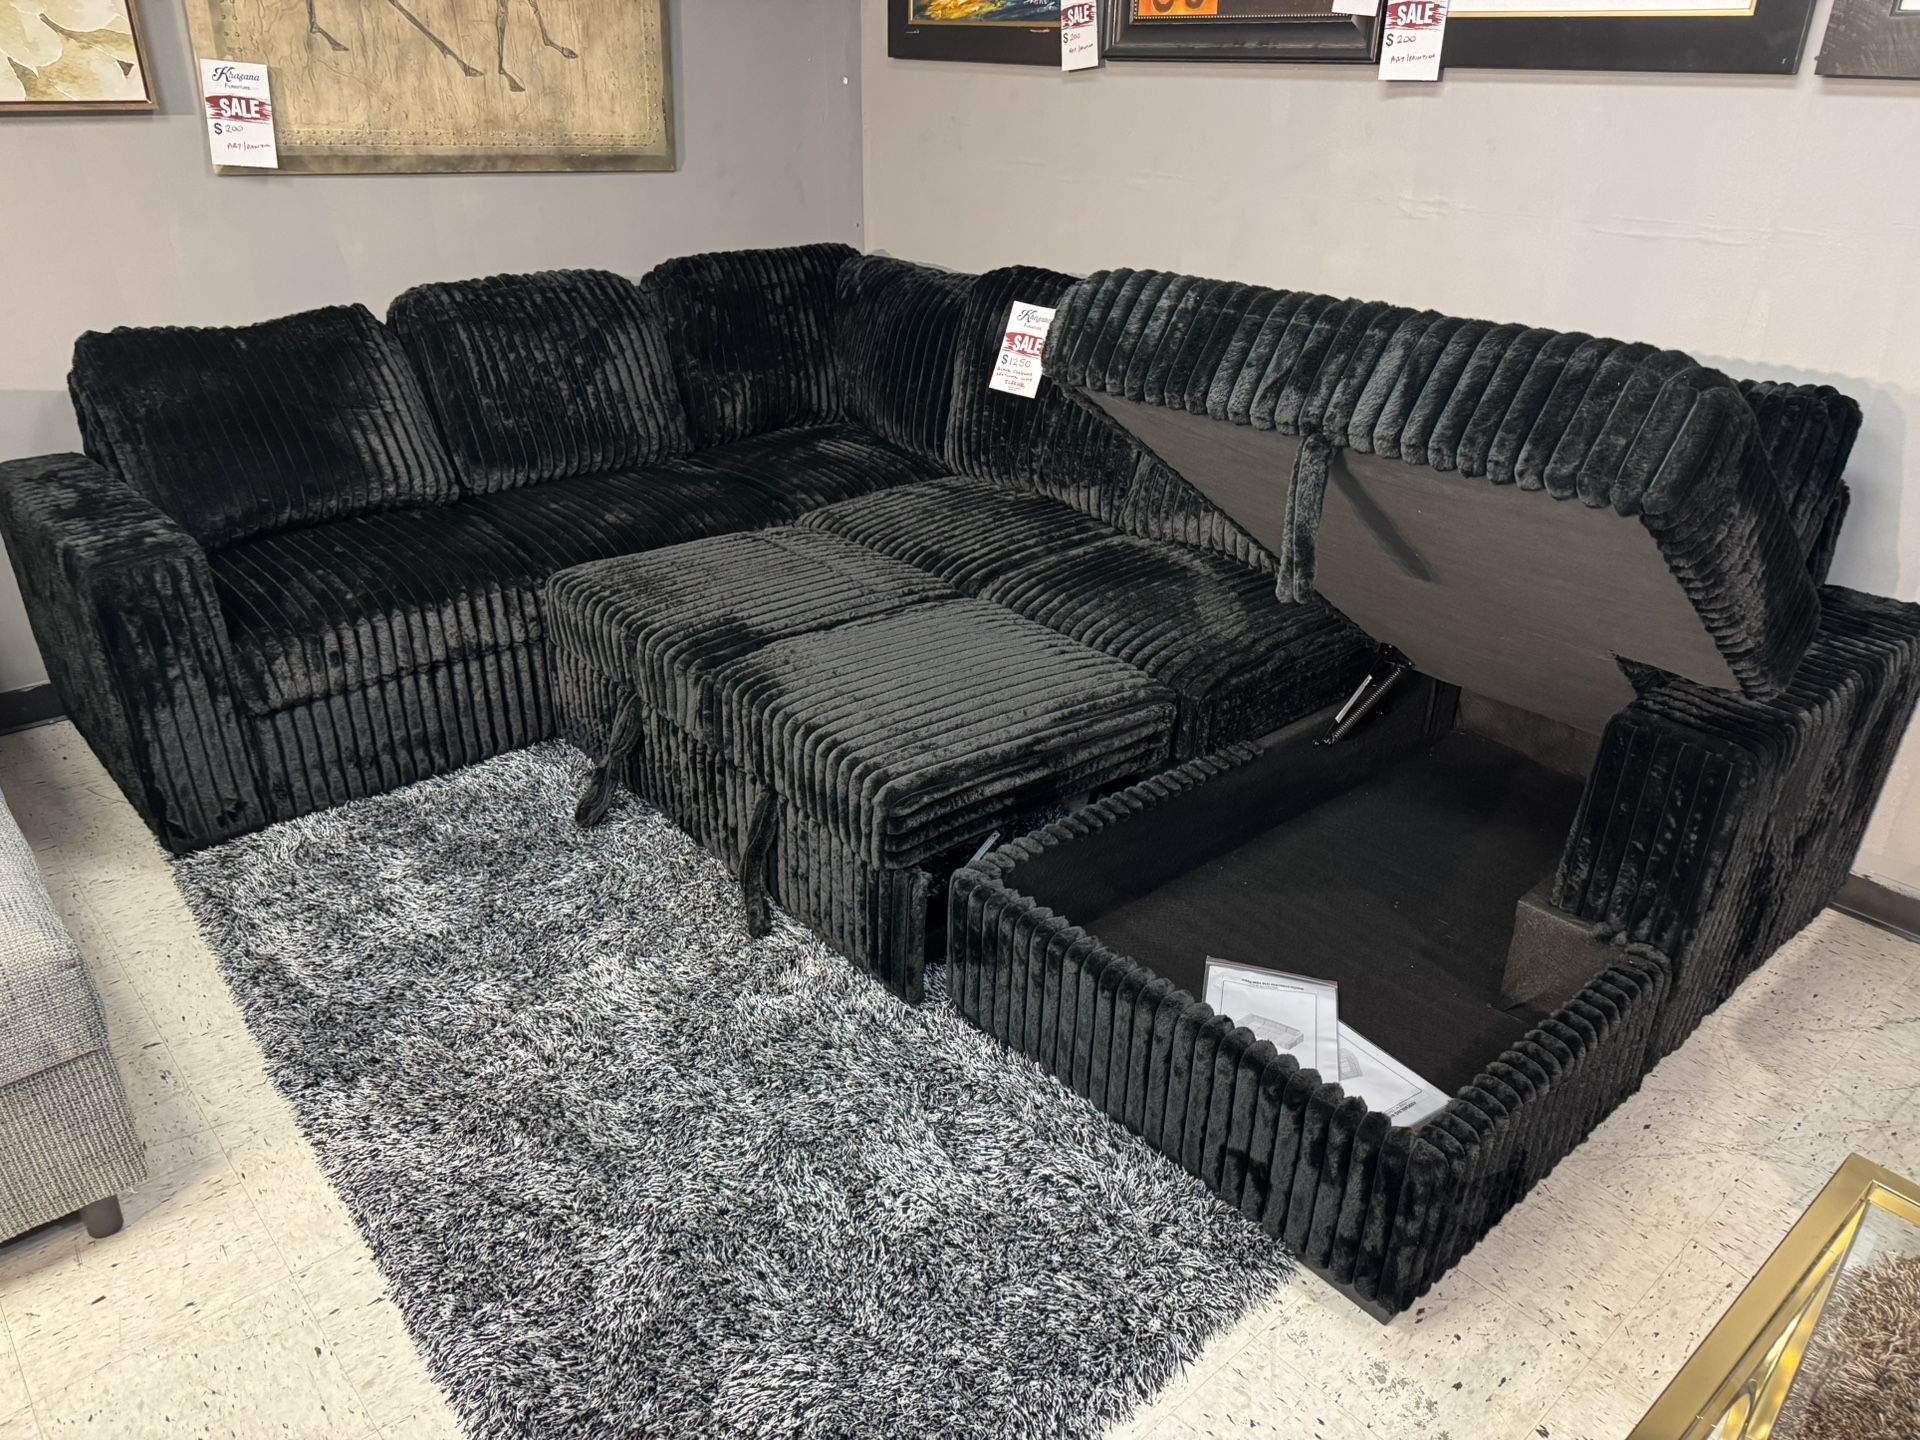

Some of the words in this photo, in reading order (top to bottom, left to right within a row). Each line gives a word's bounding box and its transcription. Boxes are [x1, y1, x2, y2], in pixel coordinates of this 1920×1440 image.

[1067, 5, 1089, 26] SALE
[1397, 3, 1434, 26] SALE
[219, 97, 261, 119] SALE
[1012, 334, 1043, 354] SALE
